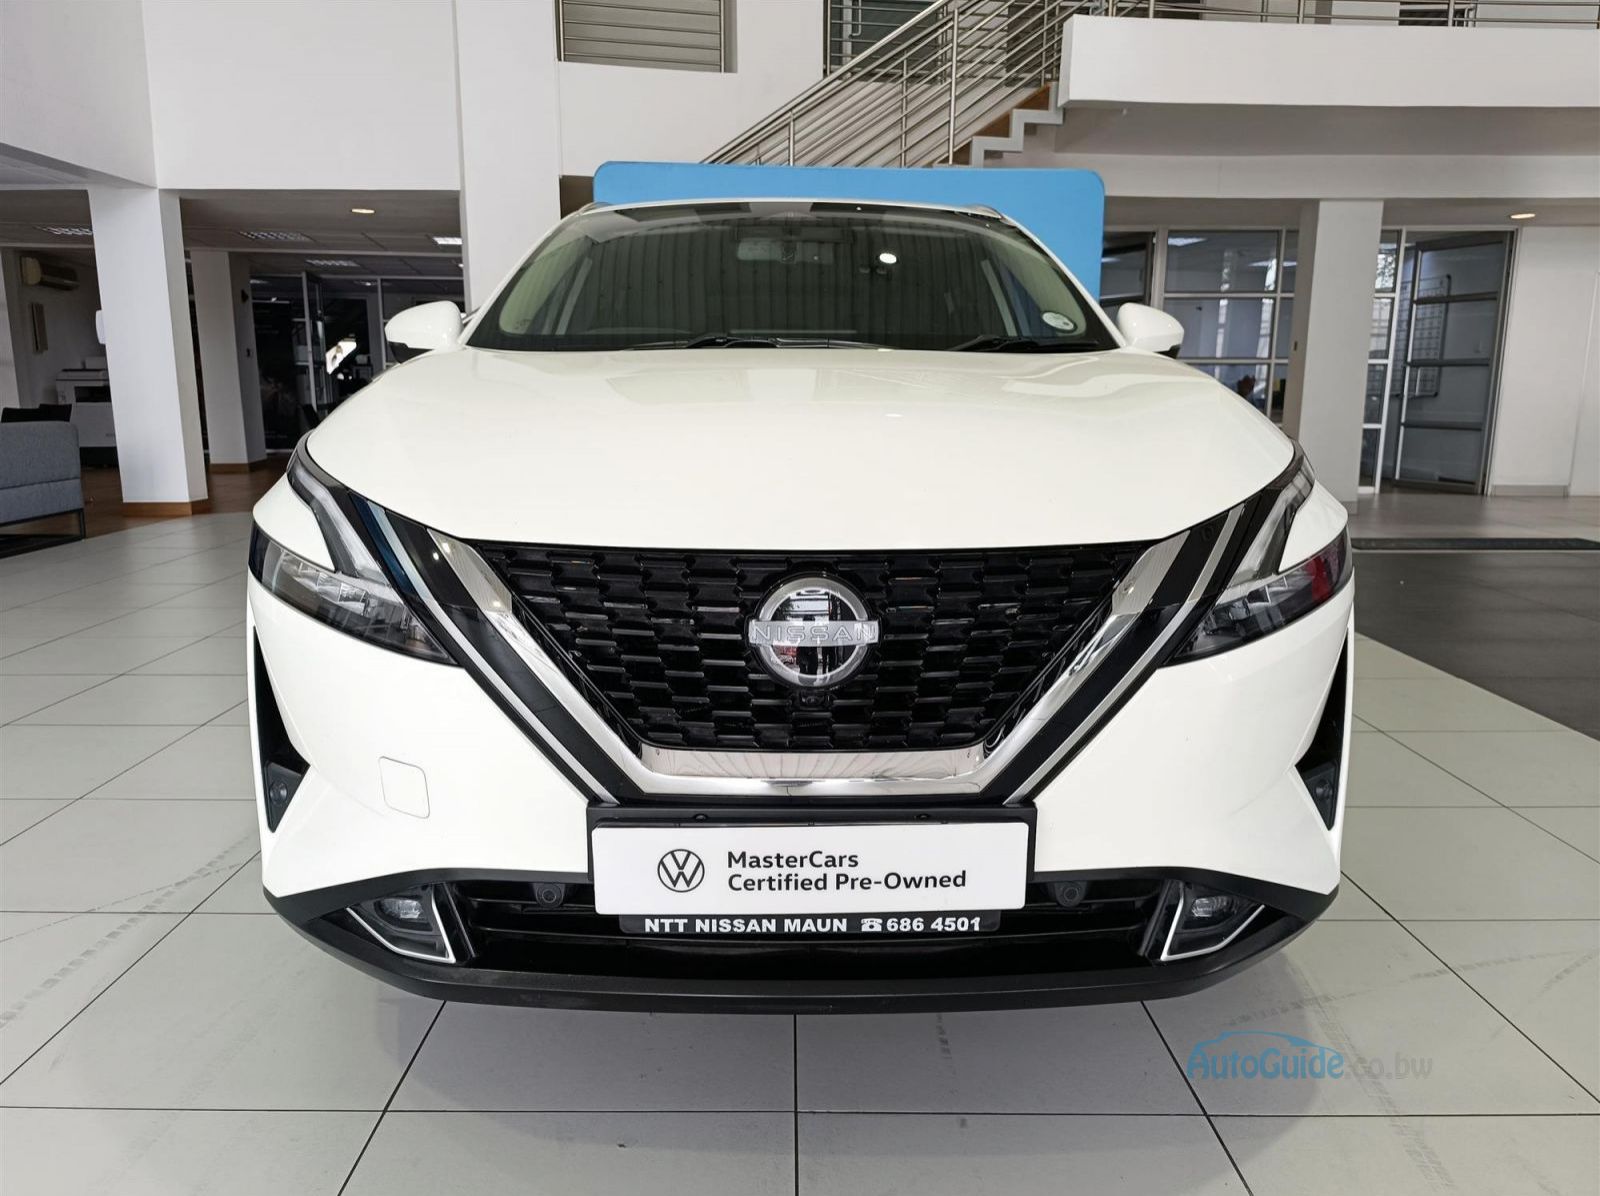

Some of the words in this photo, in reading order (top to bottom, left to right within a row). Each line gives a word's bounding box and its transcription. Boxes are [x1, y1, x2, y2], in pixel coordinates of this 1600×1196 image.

[752, 624, 876, 642] NISSAN
[727, 850, 859, 869] MasterCars
[727, 872, 828, 892] Certified
[835, 870, 967, 891] Pre-Owned
[644, 918, 688, 933] NTT
[695, 918, 777, 933] NISSAN
[783, 917, 848, 932] MAUN
[886, 917, 924, 932] 686
[930, 916, 981, 931] 4501
